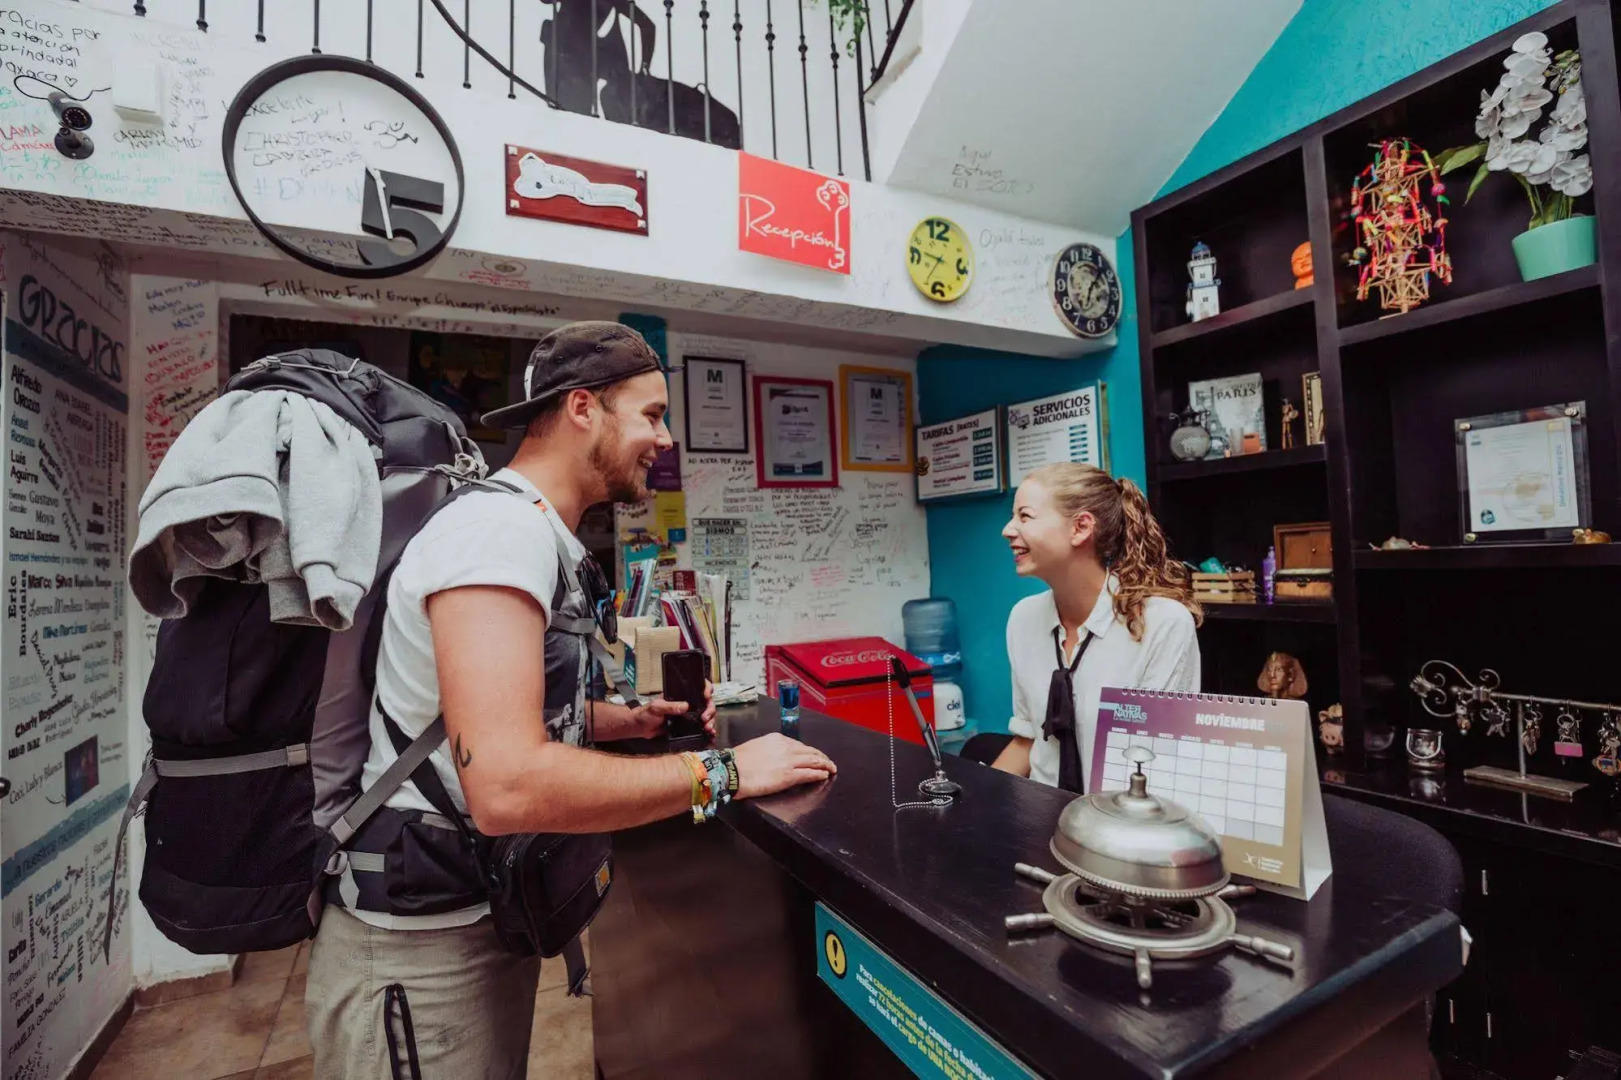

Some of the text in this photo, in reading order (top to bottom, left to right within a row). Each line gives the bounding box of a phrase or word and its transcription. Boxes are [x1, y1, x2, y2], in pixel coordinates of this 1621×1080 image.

[740, 193, 835, 249] Recepción
[925, 219, 950, 243] 12
[1070, 249, 1079, 262] 11
[1081, 247, 1092, 260] 12
[1060, 261, 1070, 273] 10
[1097, 256, 1103, 267] 1
[1106, 270, 1114, 282] 2
[1056, 279, 1066, 292] 9
[1110, 287, 1119, 300] 3
[1063, 297, 1072, 310] 8
[1109, 305, 1116, 317] 4
[1073, 312, 1081, 326] 7
[1100, 317, 1108, 329] 5
[1087, 320, 1095, 332] 6
[707, 369, 723, 383] M
[870, 388, 883, 400] M
[1216, 388, 1257, 400] PARIS
[1033, 394, 1090, 417] SERVICIOS
[1033, 407, 1091, 426] ADICIONALES
[921, 424, 953, 440] TARIFAS
[10, 465, 38, 485] Aguirre
[8, 575, 18, 619] Eric
[1113, 711, 1147, 721] NATIVAS
[859, 963, 874, 983] Para
[873, 976, 918, 1021] cancelaciones
[917, 1015, 928, 1031] de
[928, 1025, 953, 1053] camas
[886, 997, 905, 1022] horas
[905, 1017, 925, 1040] antes
[925, 1034, 935, 1050] de
[890, 1015, 899, 1028] el
[898, 1022, 917, 1046] cargo
[917, 1039, 929, 1055] de
